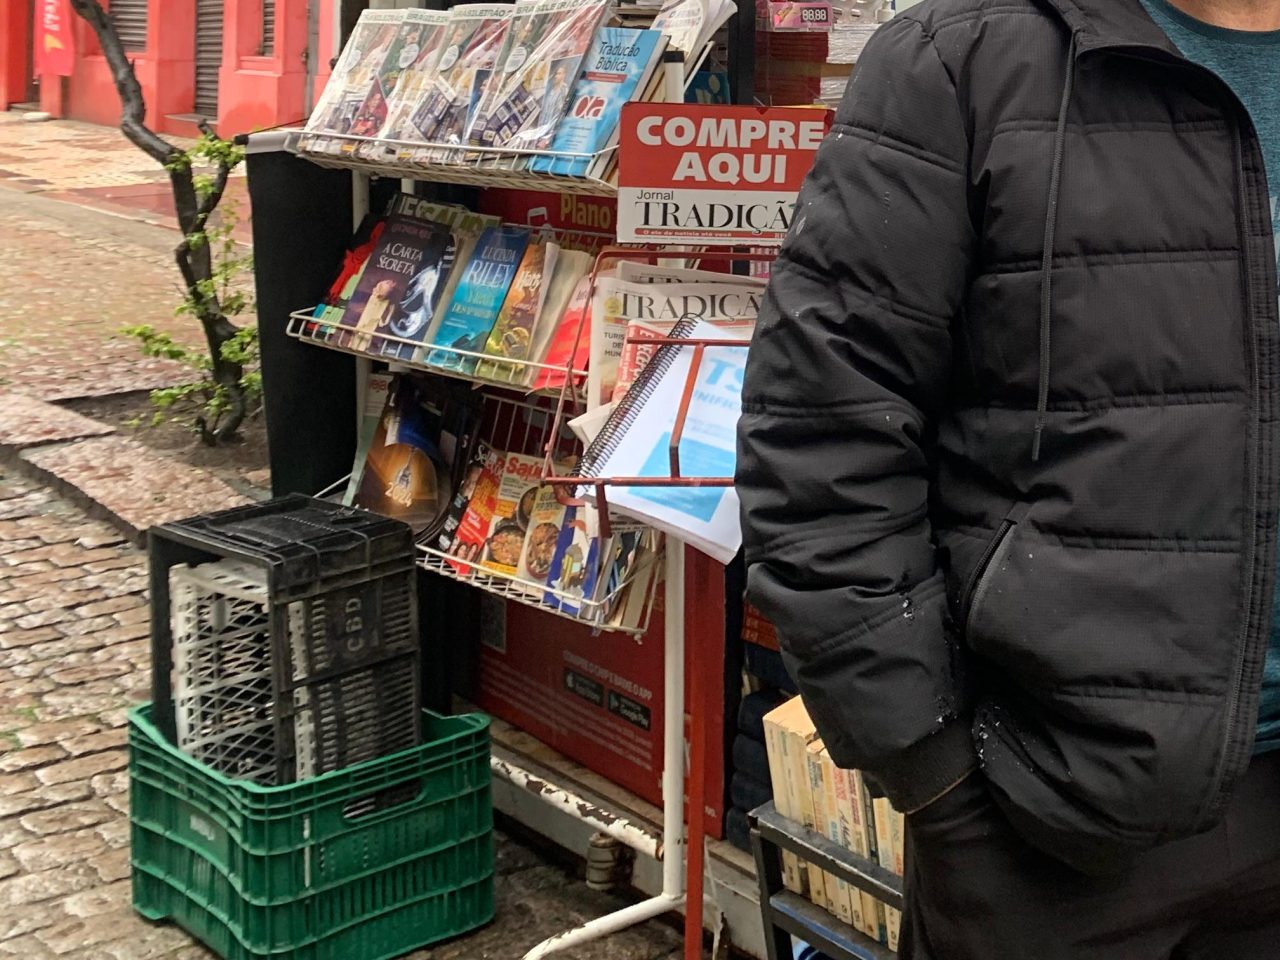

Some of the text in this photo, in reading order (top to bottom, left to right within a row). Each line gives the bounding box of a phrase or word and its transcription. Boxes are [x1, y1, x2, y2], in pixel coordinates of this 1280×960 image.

[599, 41, 641, 57] Tradução
[636, 115, 826, 150] COMPRE
[671, 151, 787, 185] AQUI
[636, 189, 674, 201] Jornal
[560, 195, 611, 229] Plano
[384, 481, 413, 508] 2024
